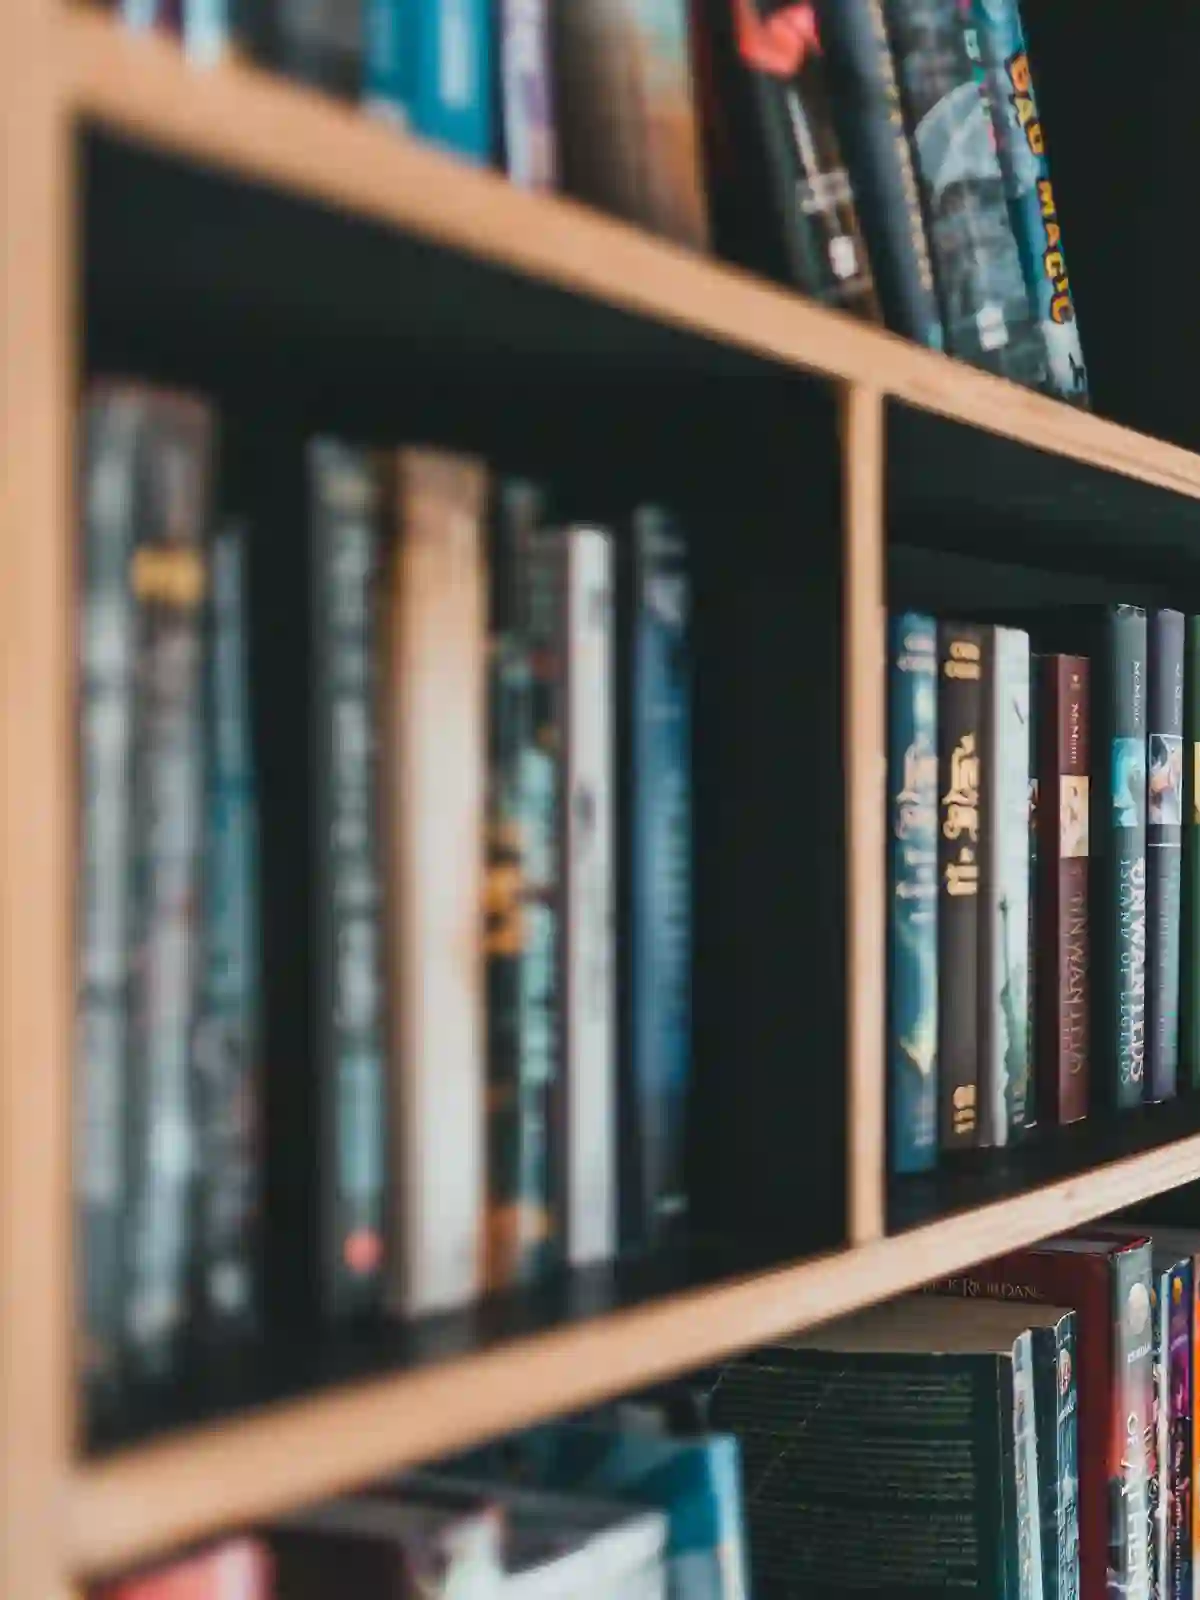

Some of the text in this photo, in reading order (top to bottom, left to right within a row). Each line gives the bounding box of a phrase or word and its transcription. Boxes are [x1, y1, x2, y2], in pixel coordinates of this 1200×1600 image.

[1006, 52, 1073, 324] BAD MAGIC
[1120, 859, 1132, 938] ISLAND
[1129, 857, 1146, 1082] UNWANTEDS
[1120, 991, 1132, 1085] LEGENDS
